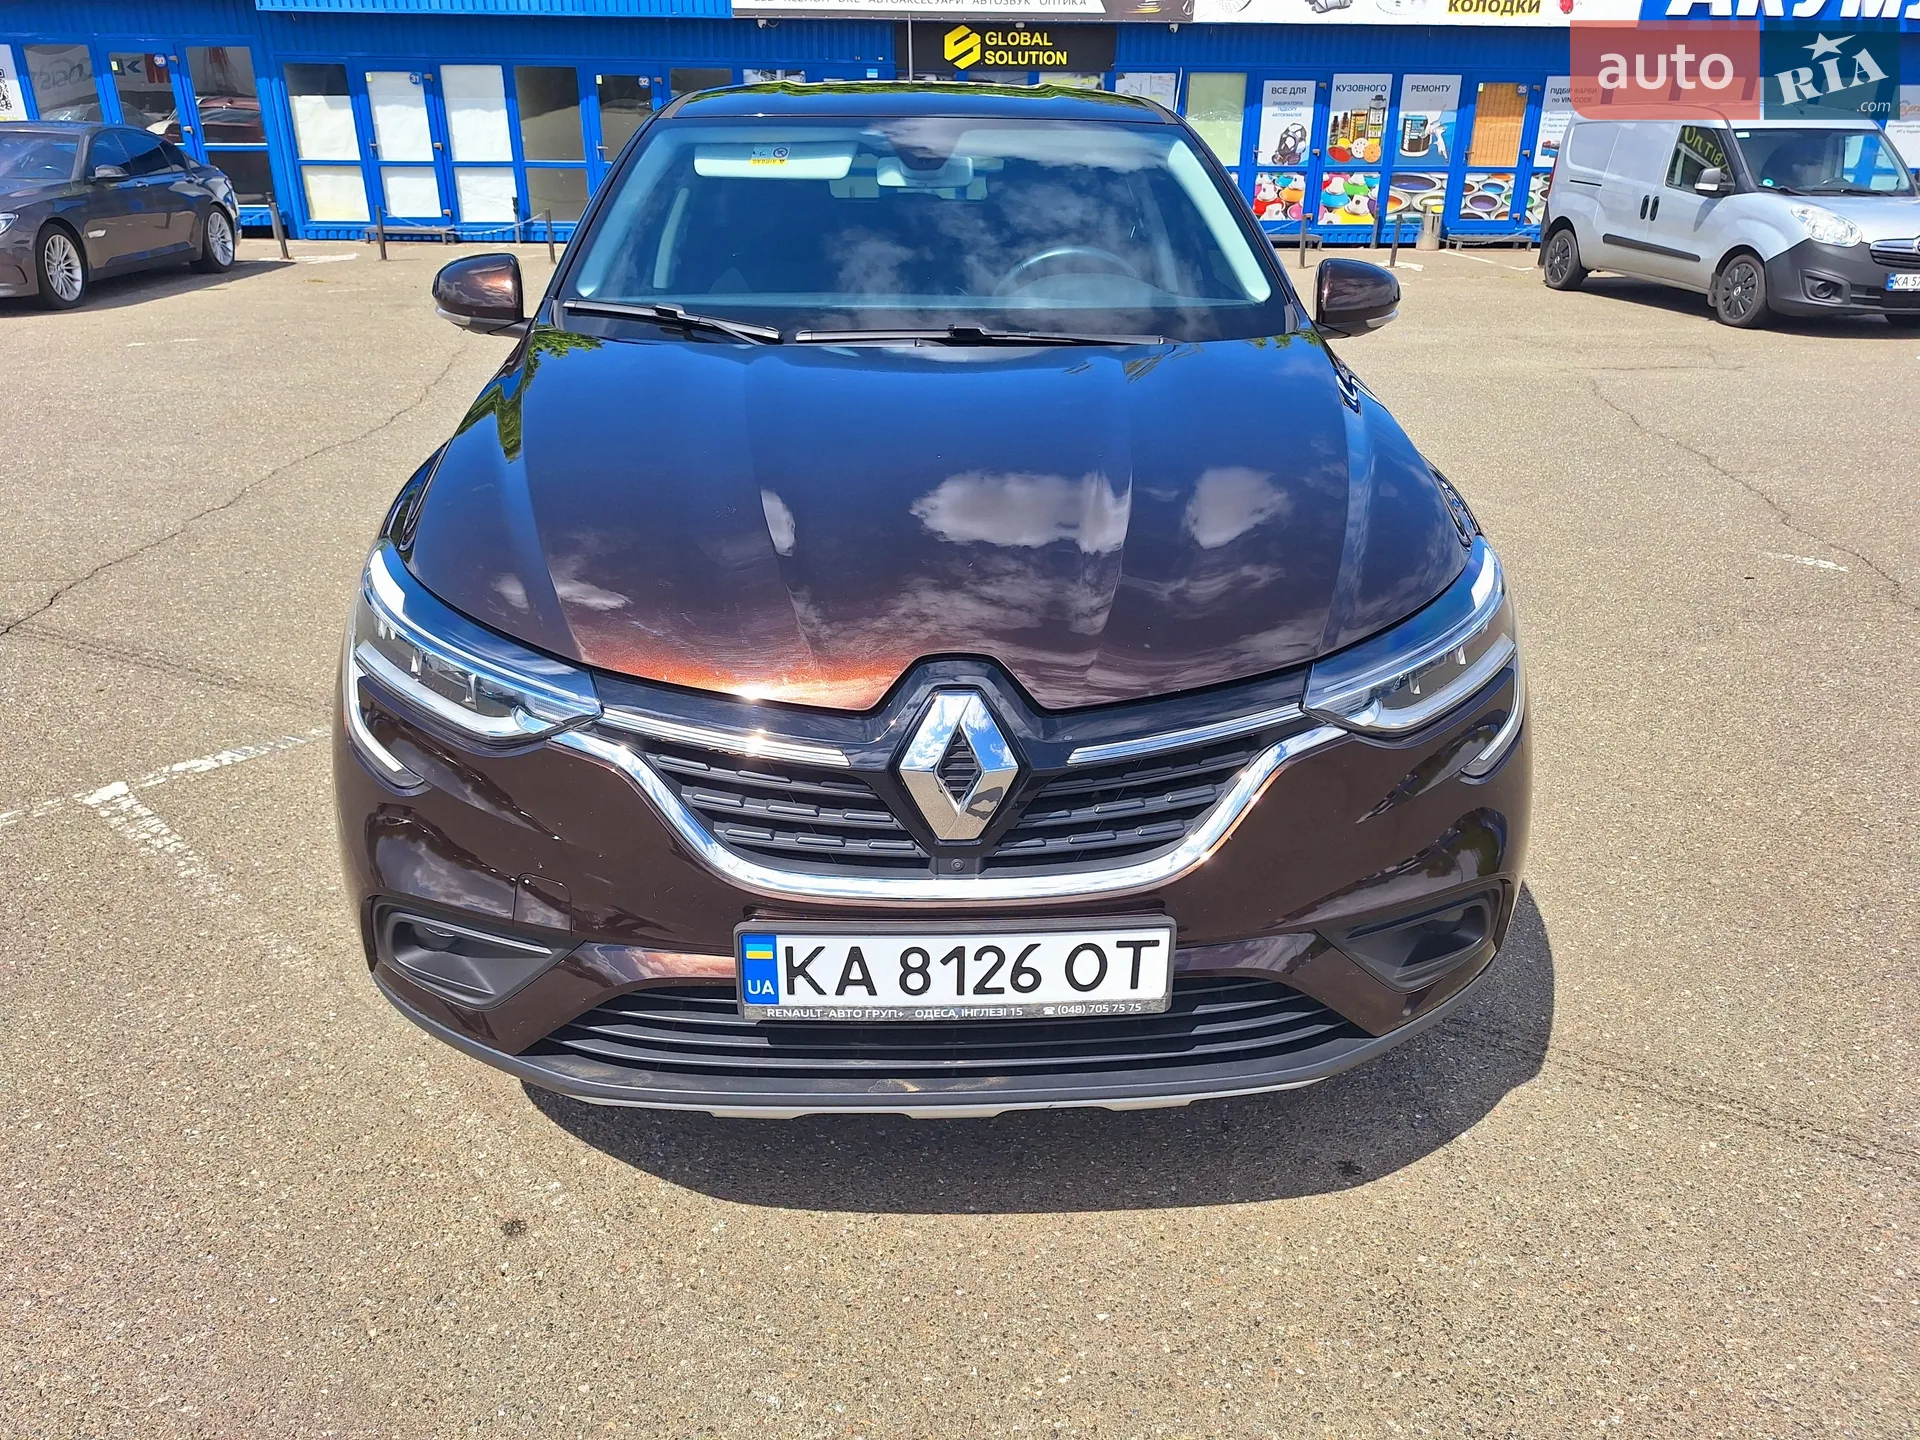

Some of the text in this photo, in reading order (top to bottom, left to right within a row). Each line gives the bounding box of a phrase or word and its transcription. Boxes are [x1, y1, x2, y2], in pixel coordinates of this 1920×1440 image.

[985, 31, 1053, 46] GLOBAL
[154, 56, 165, 65] 30
[984, 51, 1068, 65] SOLUTION
[410, 74, 420, 83] 31
[638, 77, 649, 86] 32
[1271, 86, 1307, 96] ВСЕ ДЛЯ
[1335, 84, 1387, 93] КУЗОВНОГО
[1410, 84, 1451, 93] РЕМОНТУ
[1894, 277, 1909, 287] KA
[785, 940, 1160, 996] KA 8126 OT
[747, 980, 775, 995] UA
[914, 1008, 959, 1020] ОДЕСА,
[1009, 1007, 1023, 1016] 15
[1057, 1004, 1086, 1016] (048)
[1089, 1004, 1109, 1014] 705
[1112, 1003, 1126, 1013] 75
[1128, 1003, 1142, 1012] 75
